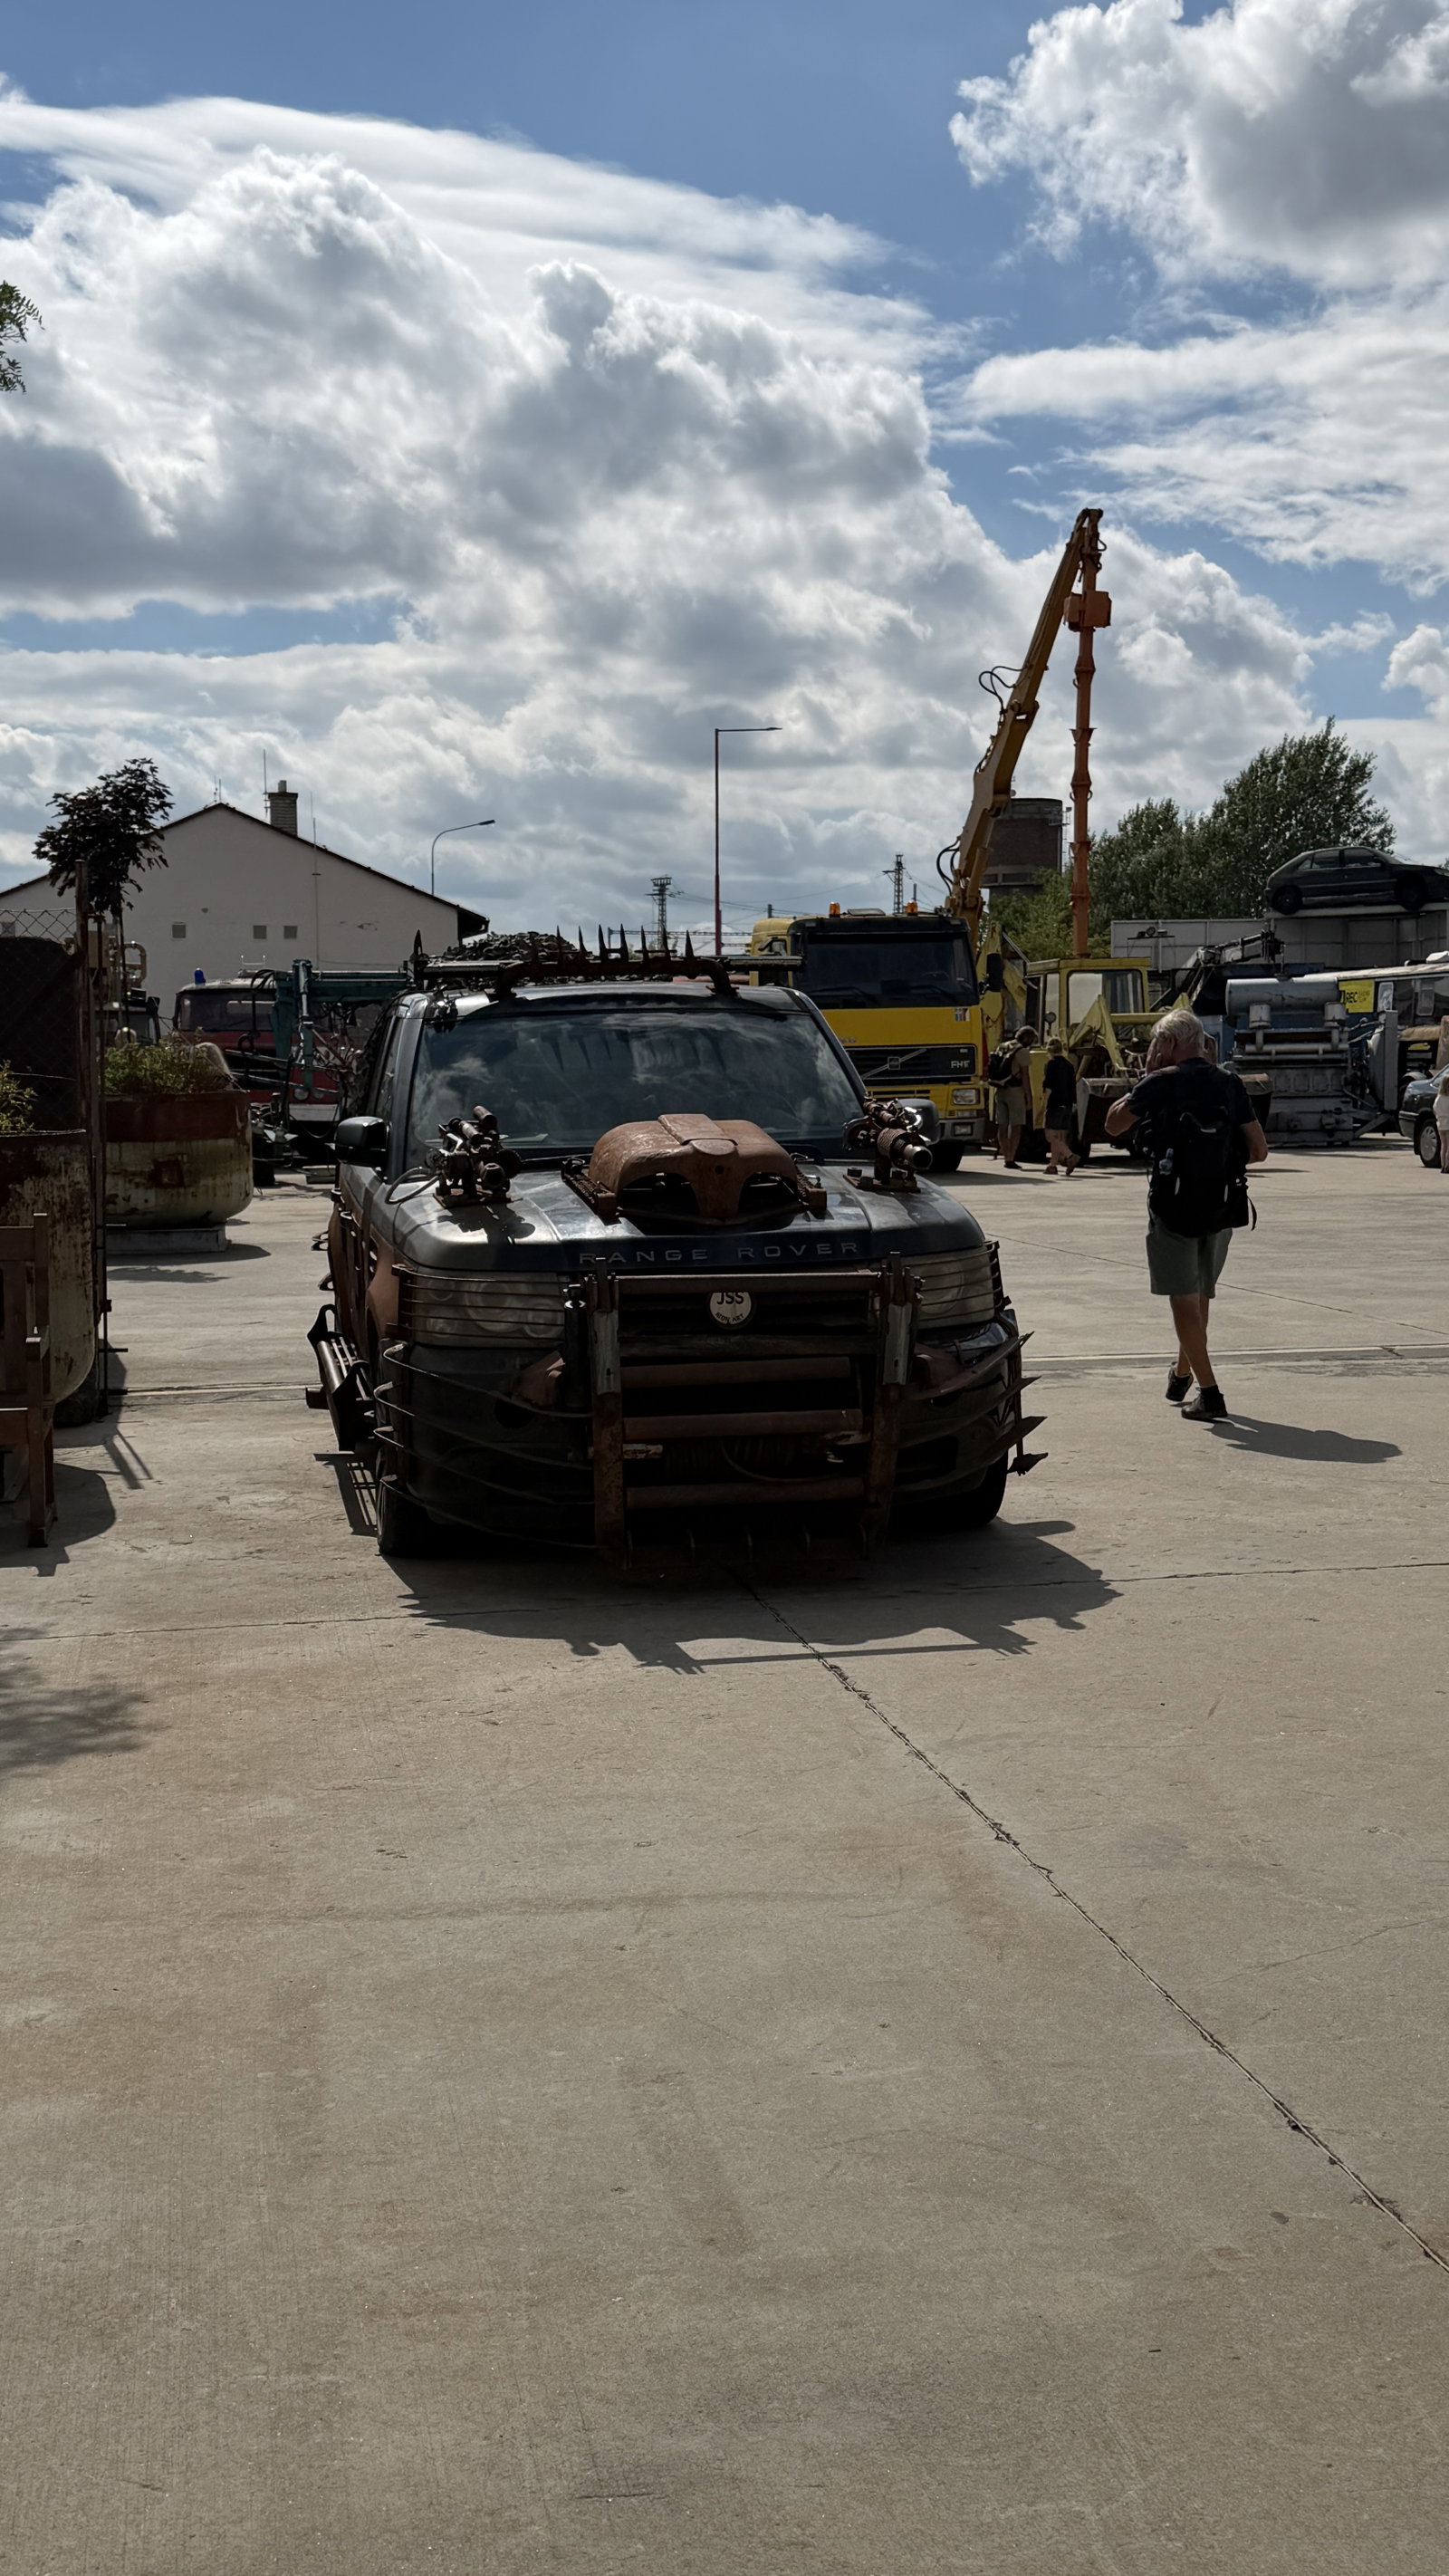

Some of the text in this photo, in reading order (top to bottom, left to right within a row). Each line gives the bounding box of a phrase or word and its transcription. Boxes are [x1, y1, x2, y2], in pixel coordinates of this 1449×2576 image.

[579, 1242, 858, 1264] RANGE ROVER
[716, 1292, 744, 1305] JSS
